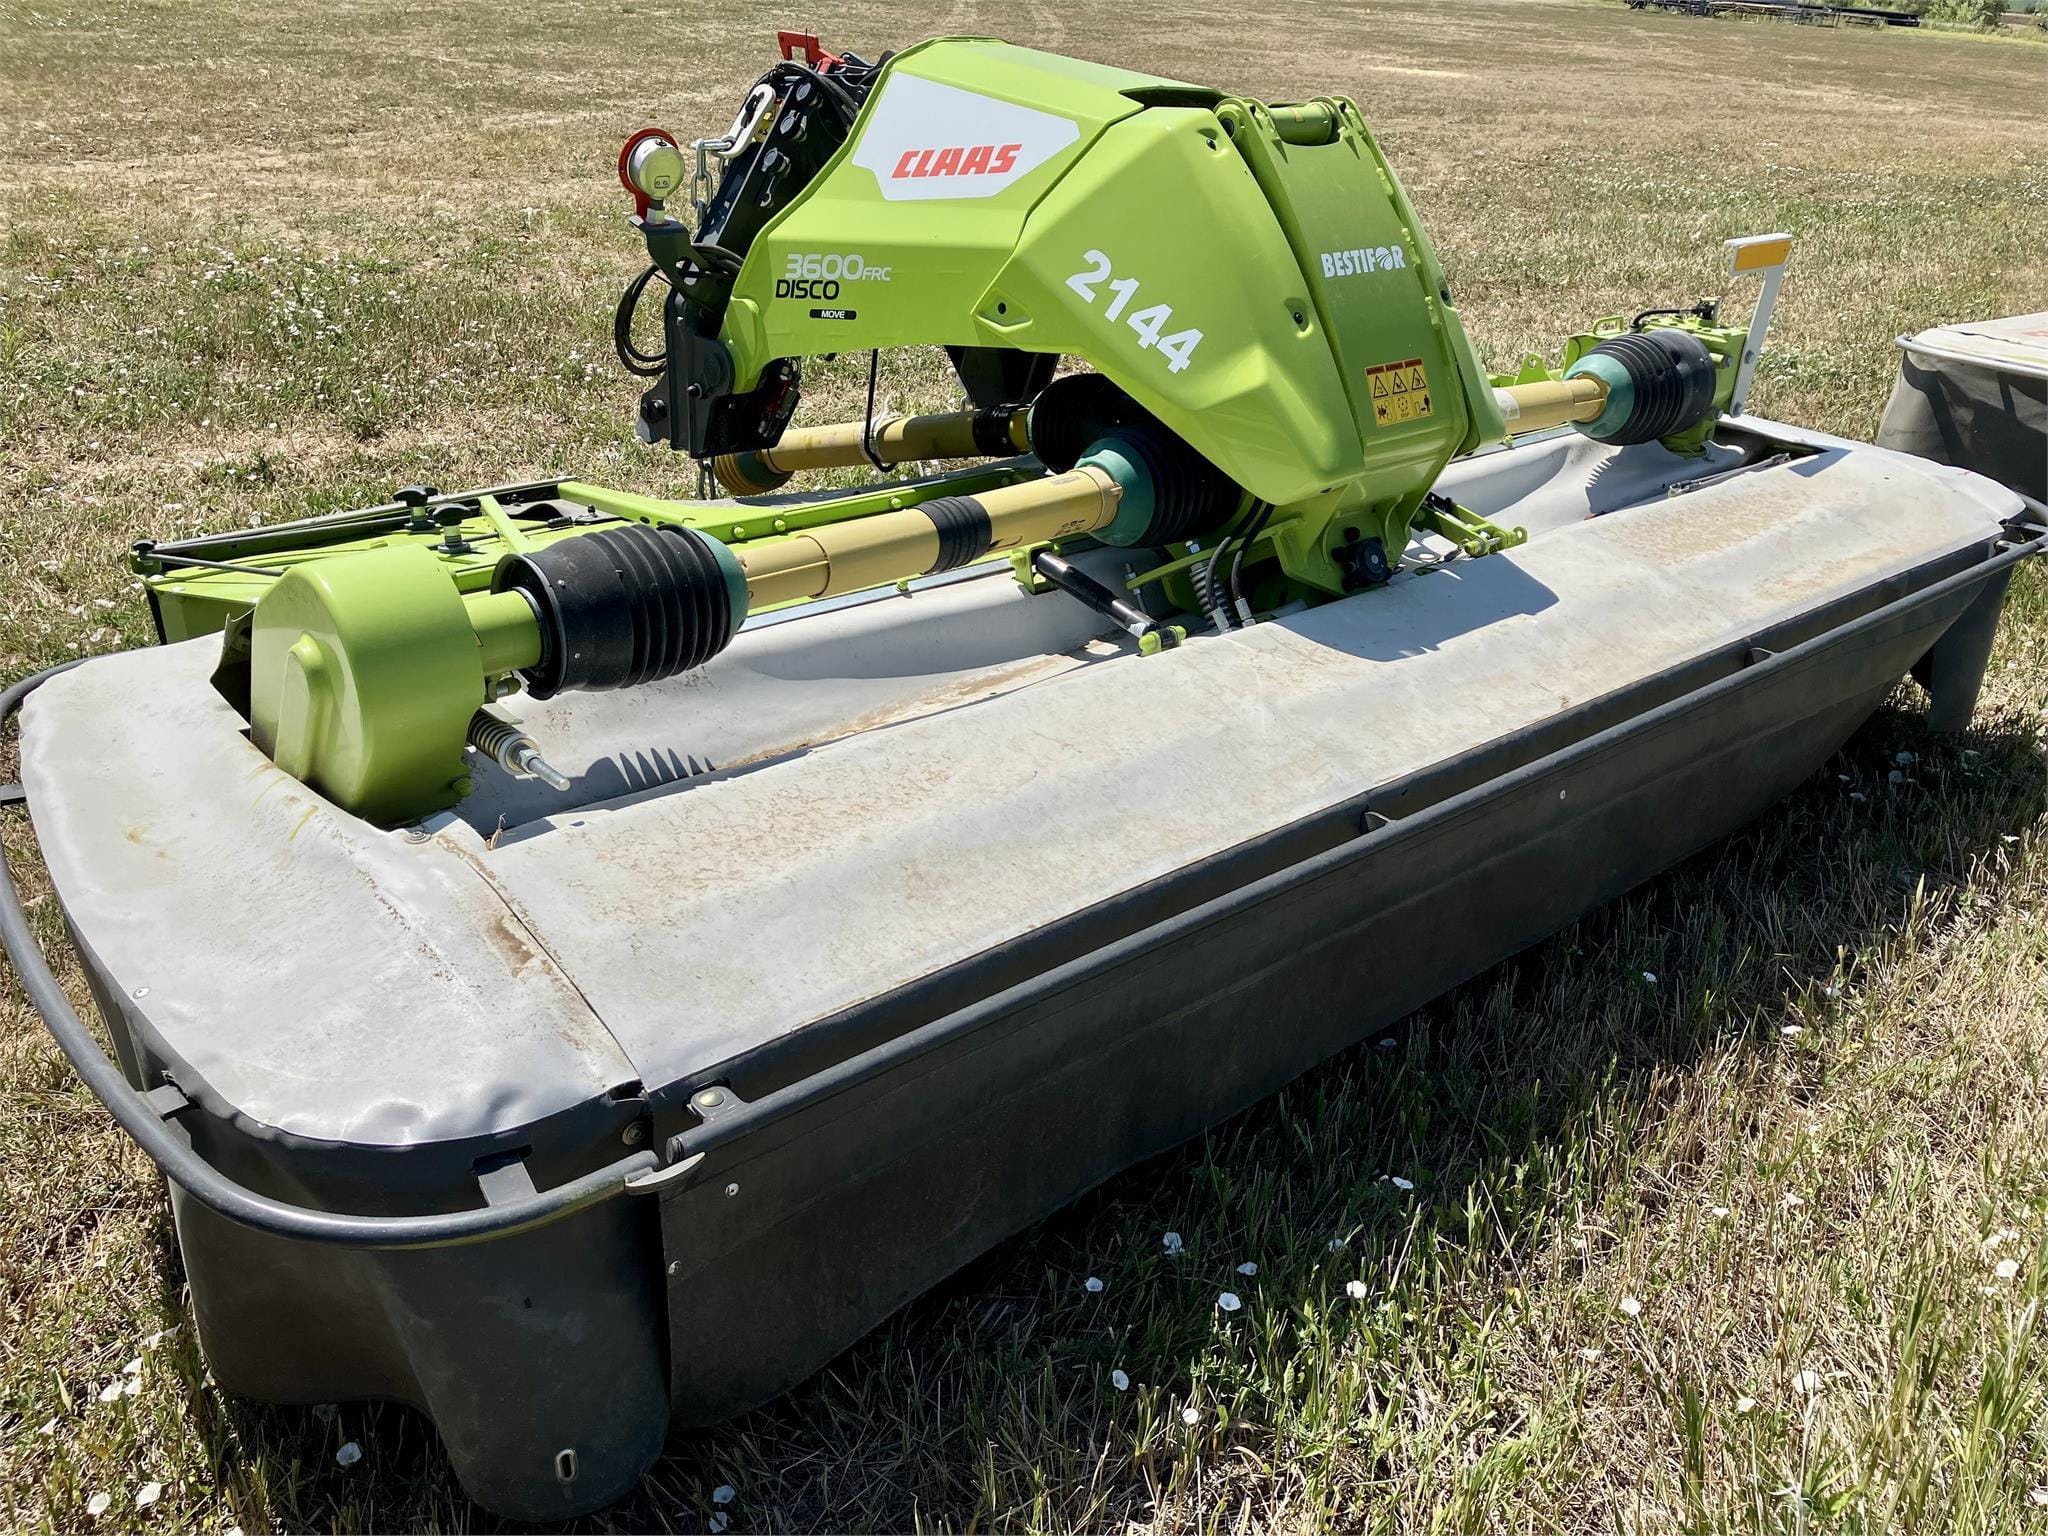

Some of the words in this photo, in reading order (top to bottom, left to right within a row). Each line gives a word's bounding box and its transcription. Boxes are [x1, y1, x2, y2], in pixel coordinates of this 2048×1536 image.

[892, 144, 1022, 178] CLAAS
[1320, 245, 1406, 278] BESTIFOR
[775, 279, 840, 300] DISCO
[821, 310, 845, 319] MOVE
[1065, 249, 1204, 374] 2144
